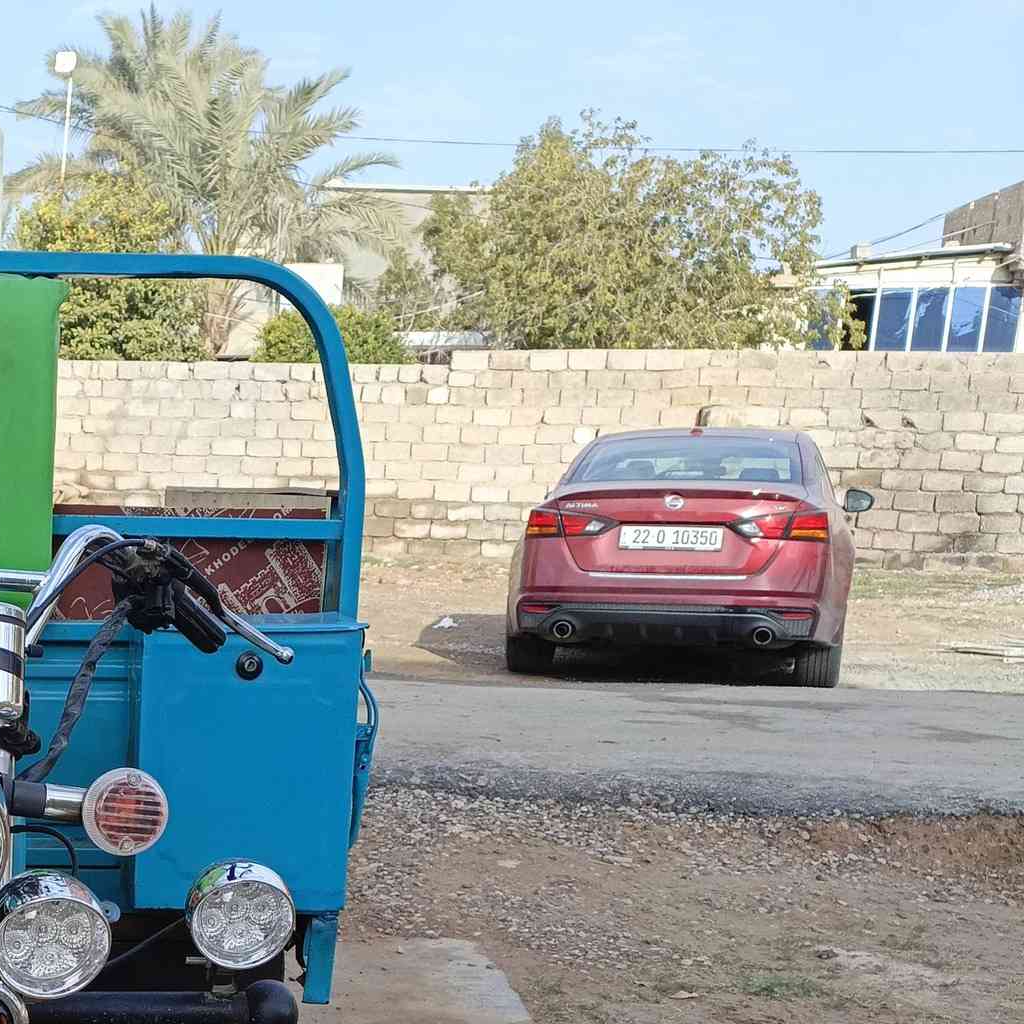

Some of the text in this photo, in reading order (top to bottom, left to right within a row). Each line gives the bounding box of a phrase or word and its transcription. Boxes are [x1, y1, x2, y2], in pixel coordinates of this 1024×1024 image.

[632, 529, 651, 544] 22
[672, 529, 718, 546] 10350
[204, 540, 253, 576] KHODE
